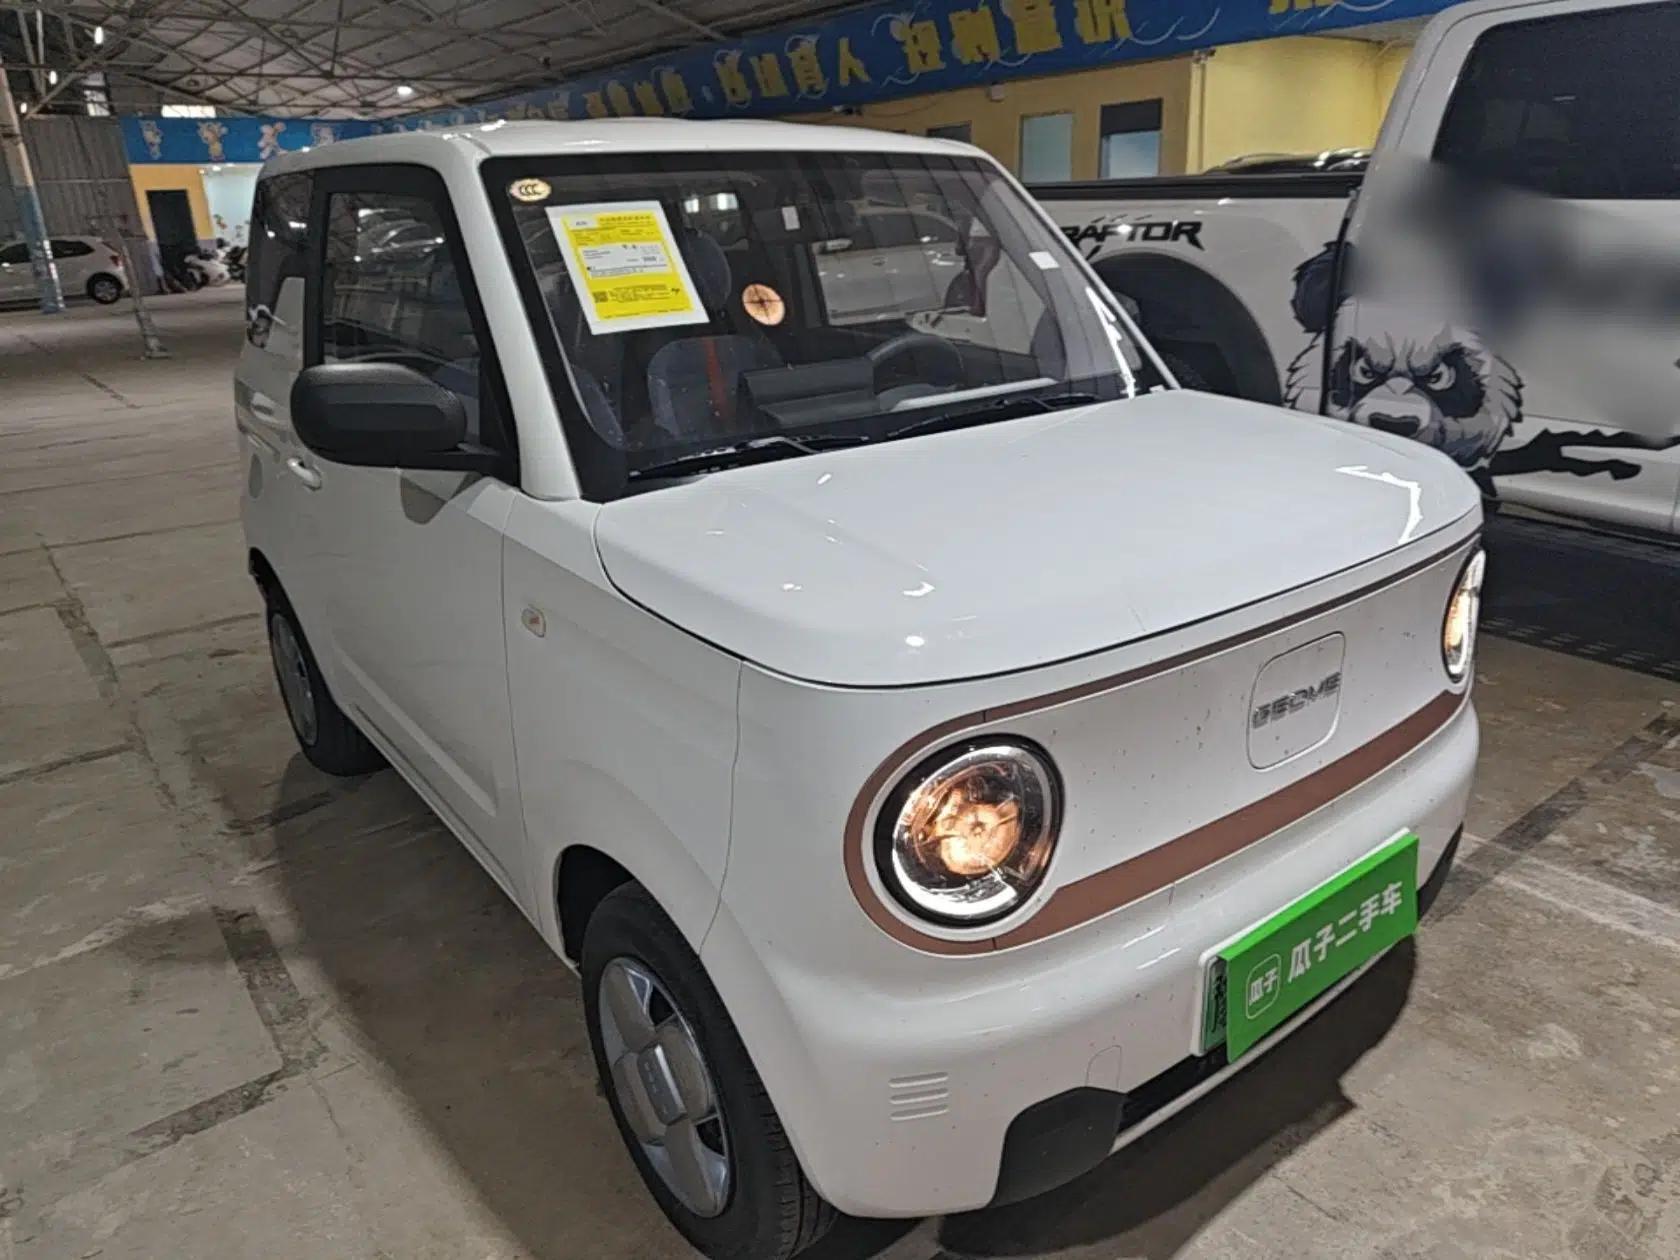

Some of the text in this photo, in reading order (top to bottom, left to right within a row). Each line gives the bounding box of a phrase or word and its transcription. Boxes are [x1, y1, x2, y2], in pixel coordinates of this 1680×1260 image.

[517, 183, 543, 196] CCC
[1288, 881, 1403, 983] 瓜子二手车
[1249, 968, 1279, 1004] 瓜子
